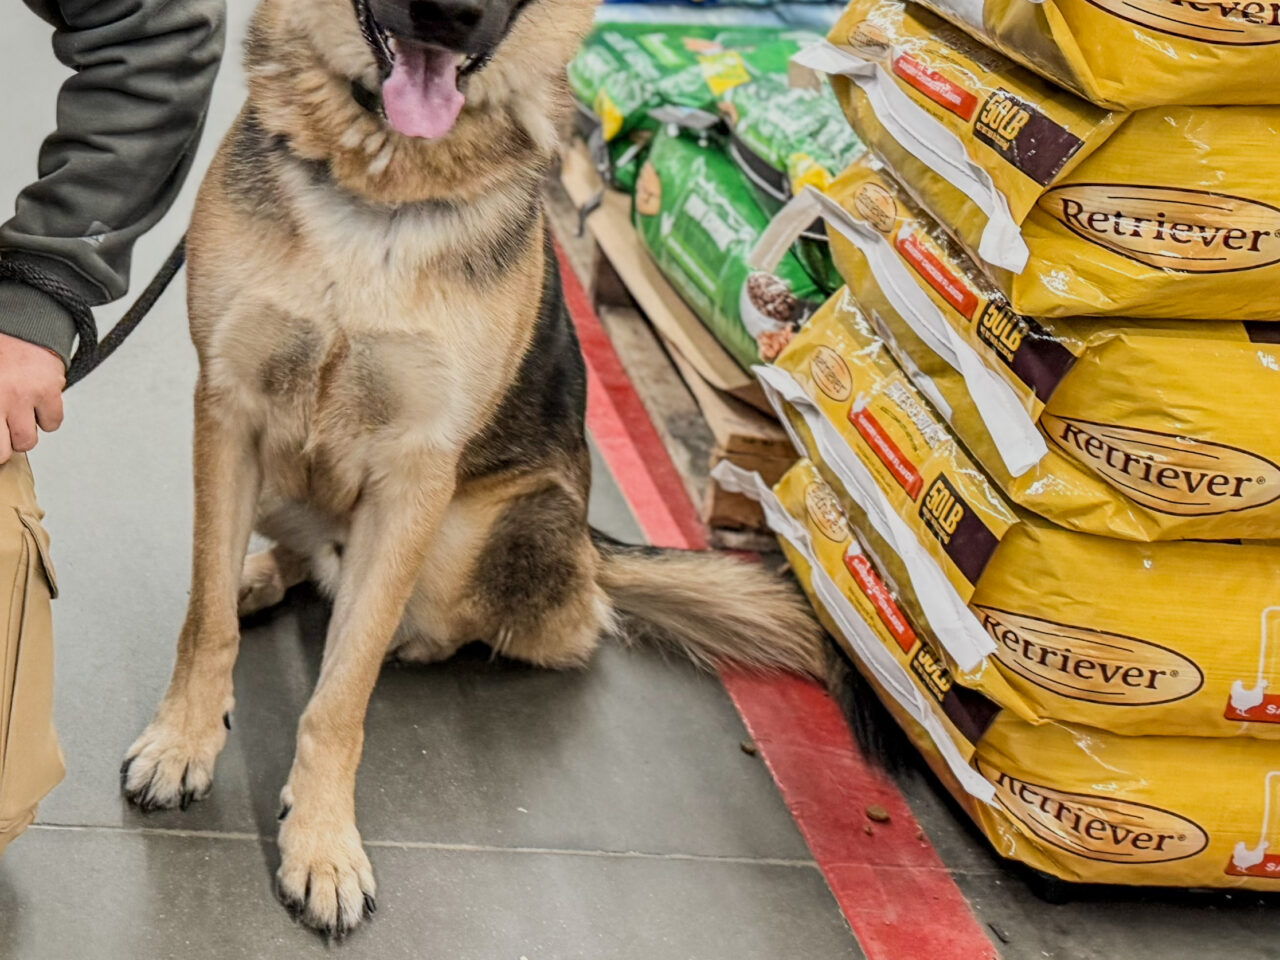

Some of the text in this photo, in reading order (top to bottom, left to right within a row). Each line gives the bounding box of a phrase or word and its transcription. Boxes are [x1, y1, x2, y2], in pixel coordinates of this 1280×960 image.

[981, 95, 1031, 141] 50LB
[983, 303, 1028, 352] 50LB
[924, 479, 966, 534] 50LB
